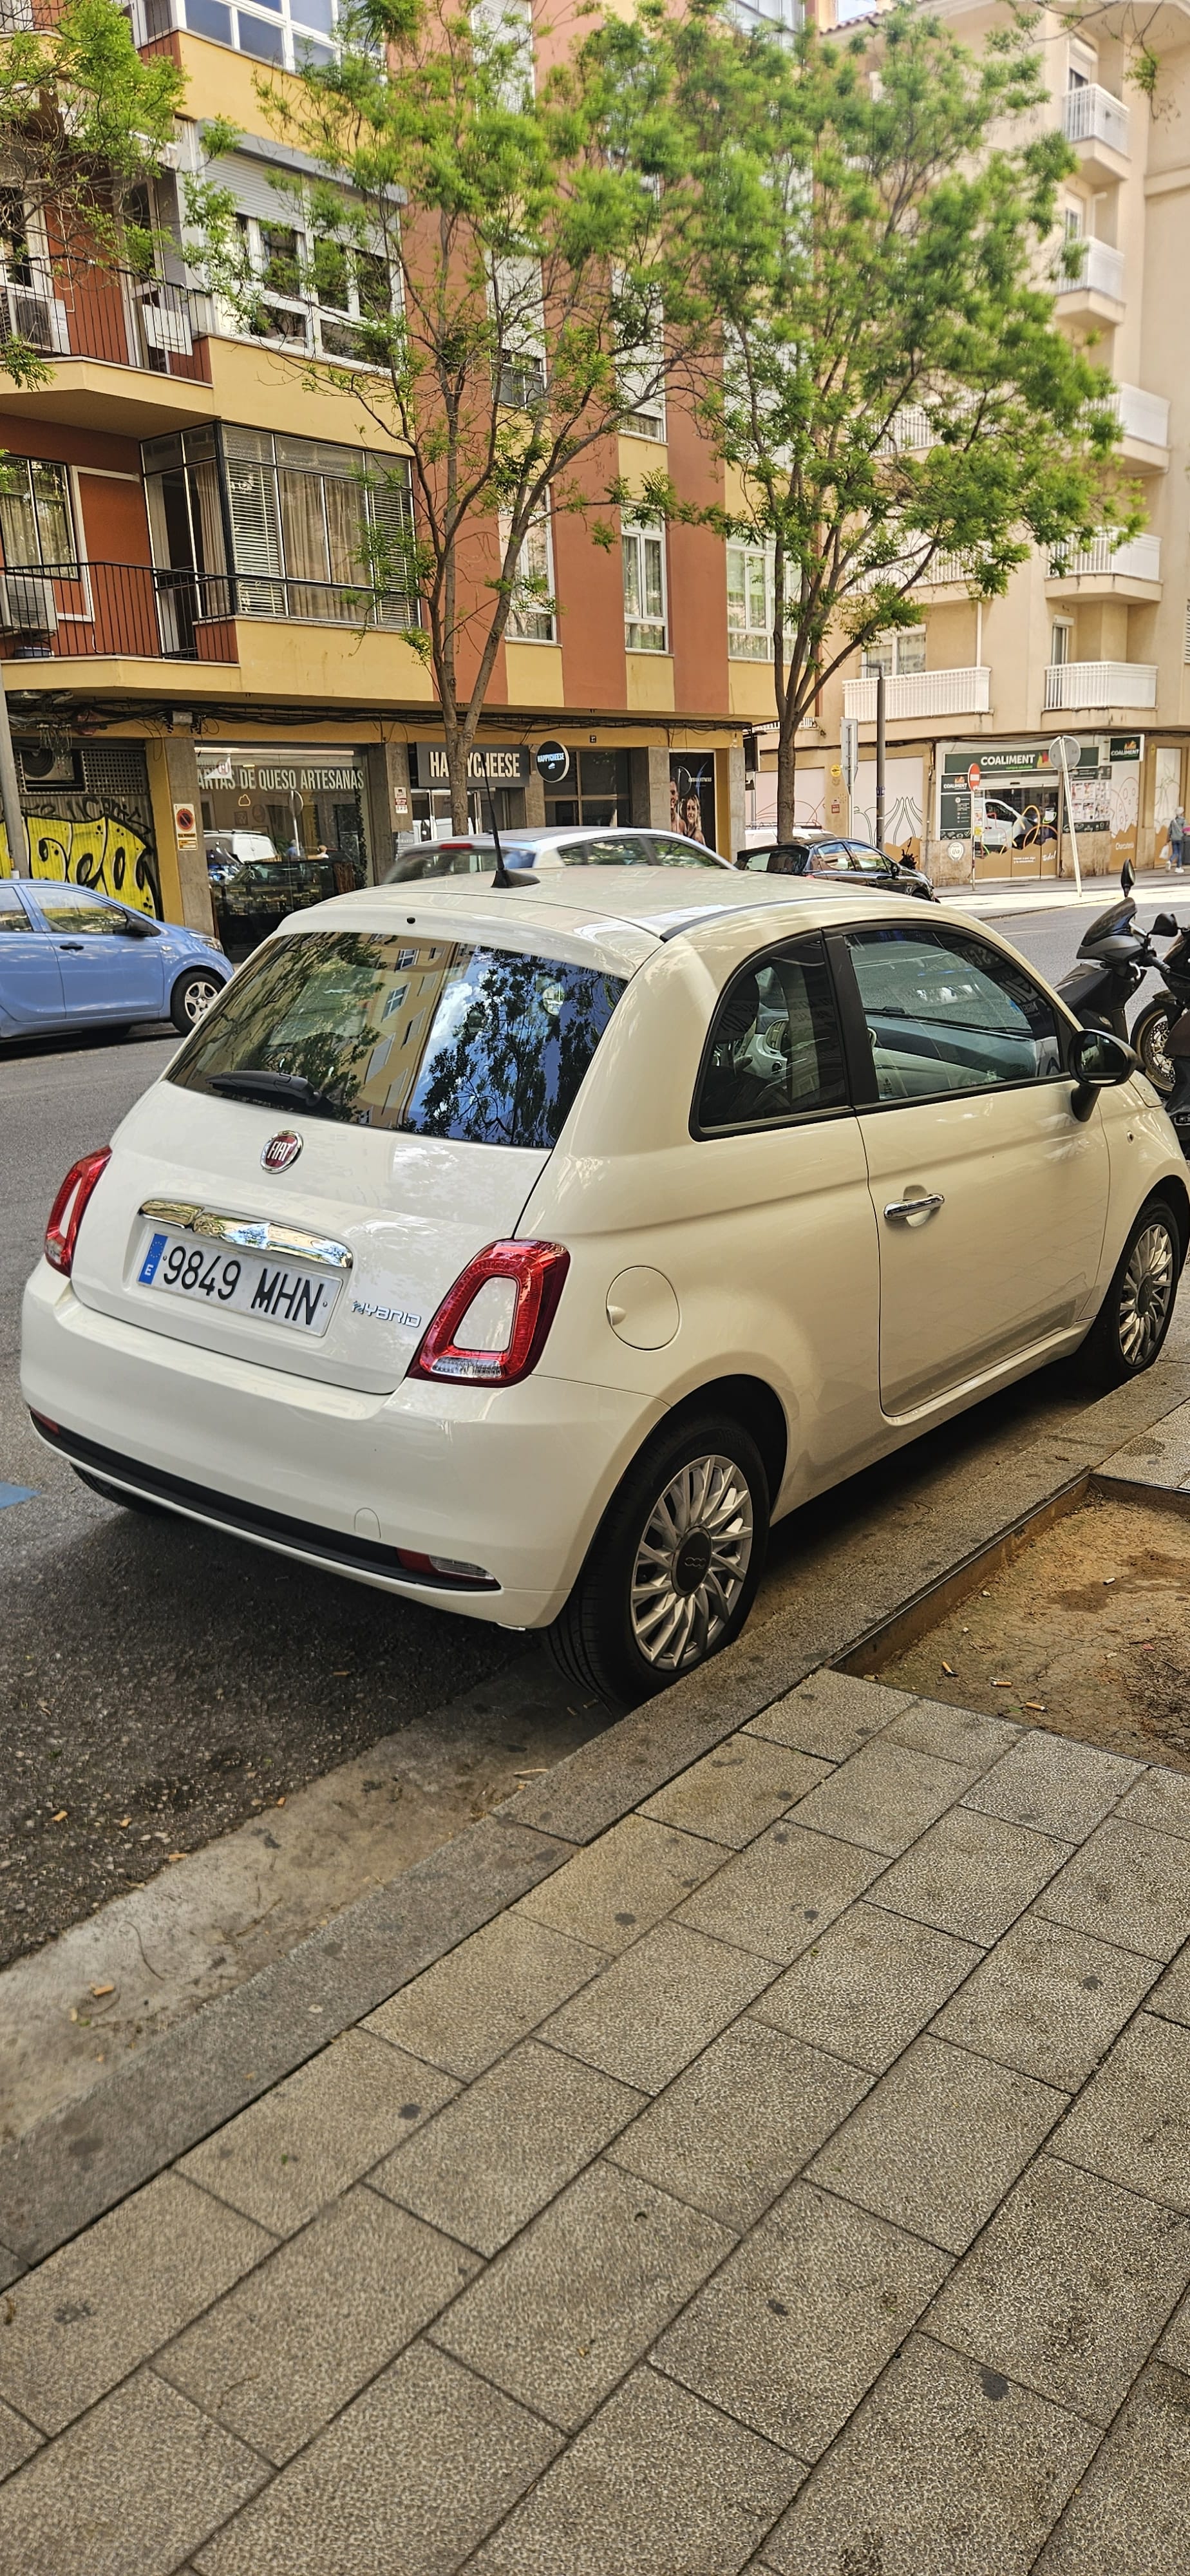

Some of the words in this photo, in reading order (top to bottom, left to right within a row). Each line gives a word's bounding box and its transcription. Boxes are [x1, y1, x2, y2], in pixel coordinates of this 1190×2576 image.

[430, 752, 520, 777] HAYCHEESE
[537, 752, 565, 762] HAPPYCHEESE
[981, 754, 1035, 766] COALIMENT
[198, 768, 235, 790] ARTAS
[240, 769, 256, 790] DE
[259, 770, 297, 791] QUESO
[300, 770, 364, 790] ARTESANAS
[267, 1141, 296, 1161] FIAT
[144, 1264, 154, 1276] E
[164, 1245, 241, 1300] 9849
[250, 1267, 325, 1325] MHN
[352, 1301, 422, 1328] HYBRID
